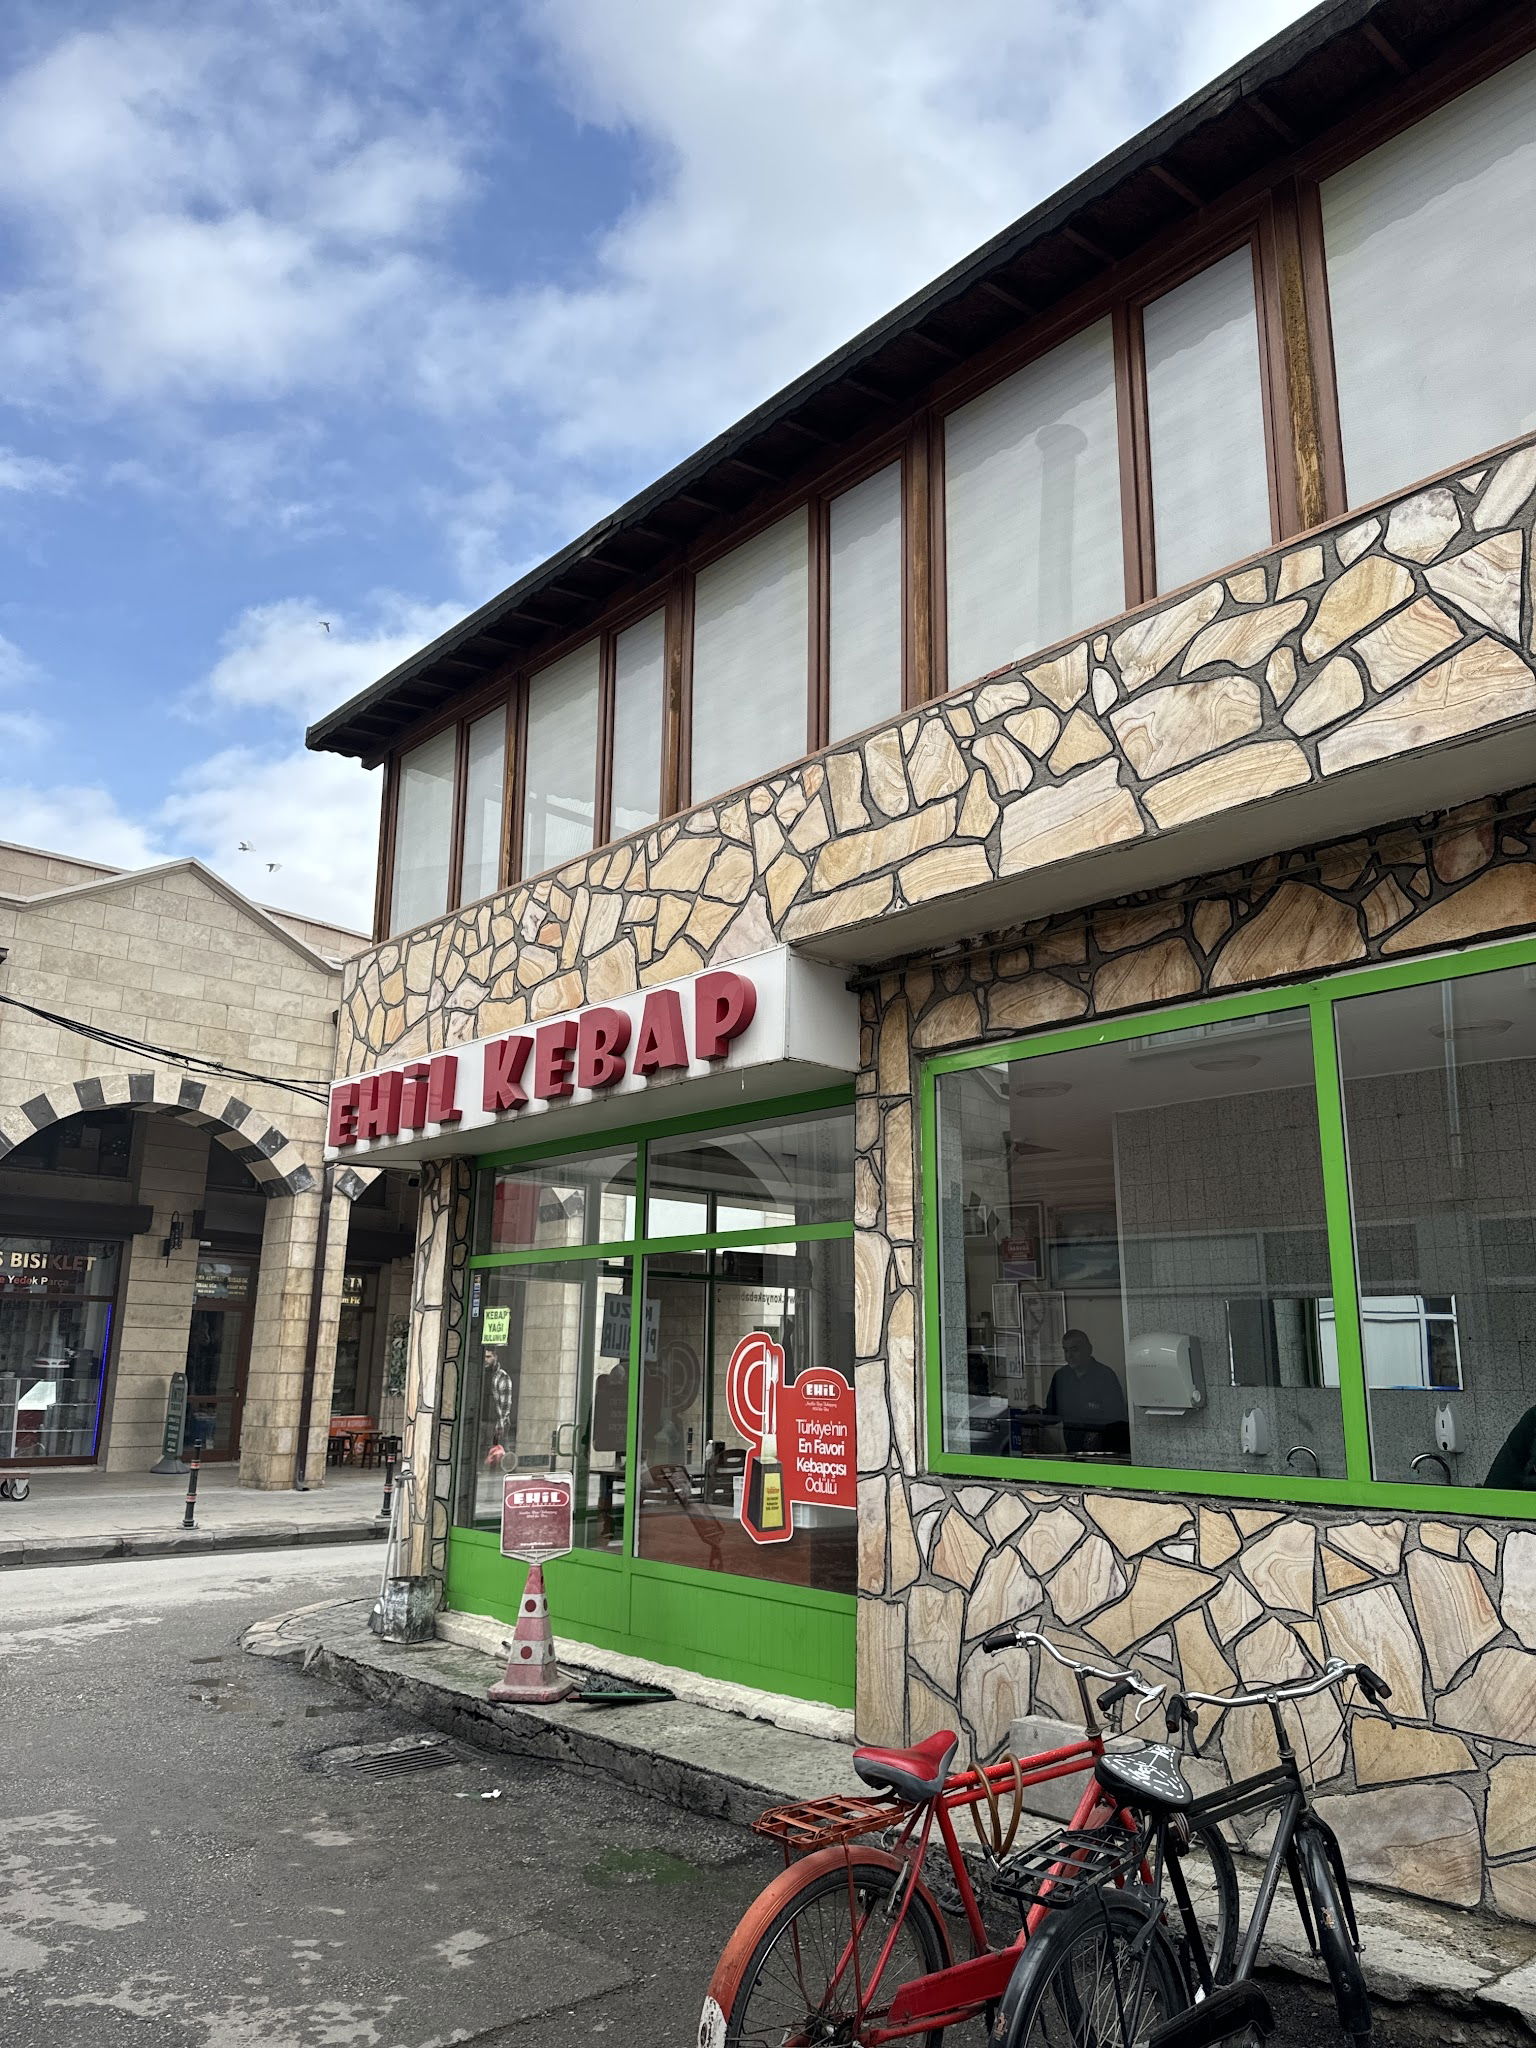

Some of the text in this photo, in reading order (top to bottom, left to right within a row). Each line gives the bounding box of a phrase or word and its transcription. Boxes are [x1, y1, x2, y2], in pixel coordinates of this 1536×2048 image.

[482, 970, 758, 1112] KEBAP
[7, 1275, 39, 1285] Yedek
[486, 1311, 507, 1319] KEBAP
[795, 1418, 848, 1439] Türkiye'nin
[798, 1437, 845, 1456] En Favori
[796, 1456, 847, 1478] Kebapçısı
[805, 1473, 837, 1495] Ödülü
